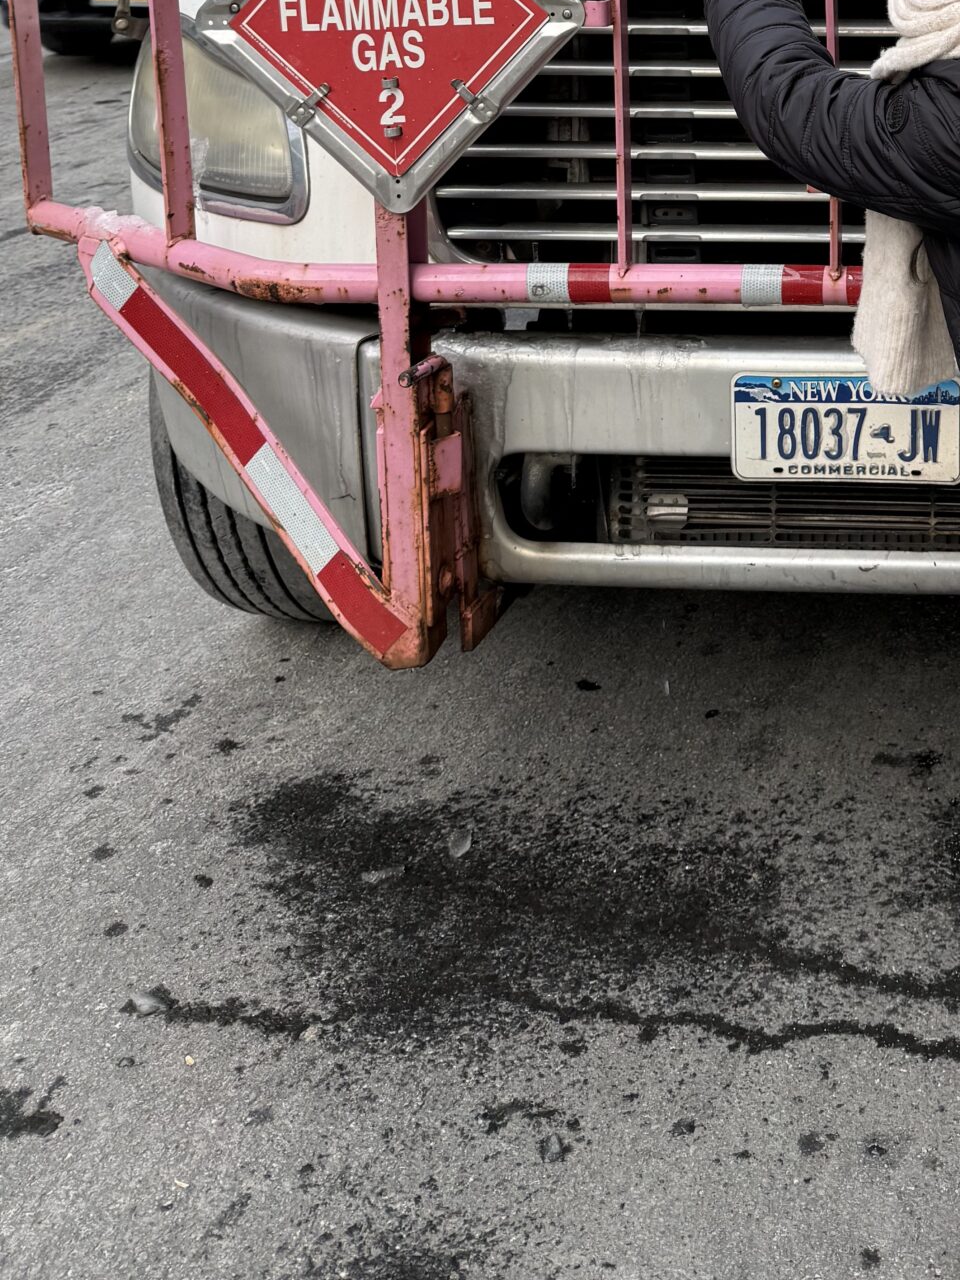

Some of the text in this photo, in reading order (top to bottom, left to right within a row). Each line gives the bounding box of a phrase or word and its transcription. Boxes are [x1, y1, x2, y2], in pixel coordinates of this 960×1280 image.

[352, 30, 426, 72] GAS
[378, 88, 406, 126] 2
[788, 381, 907, 403] NEW YO
[755, 407, 941, 464] 18037 JW
[788, 463, 912, 477] COMMERCIAL
